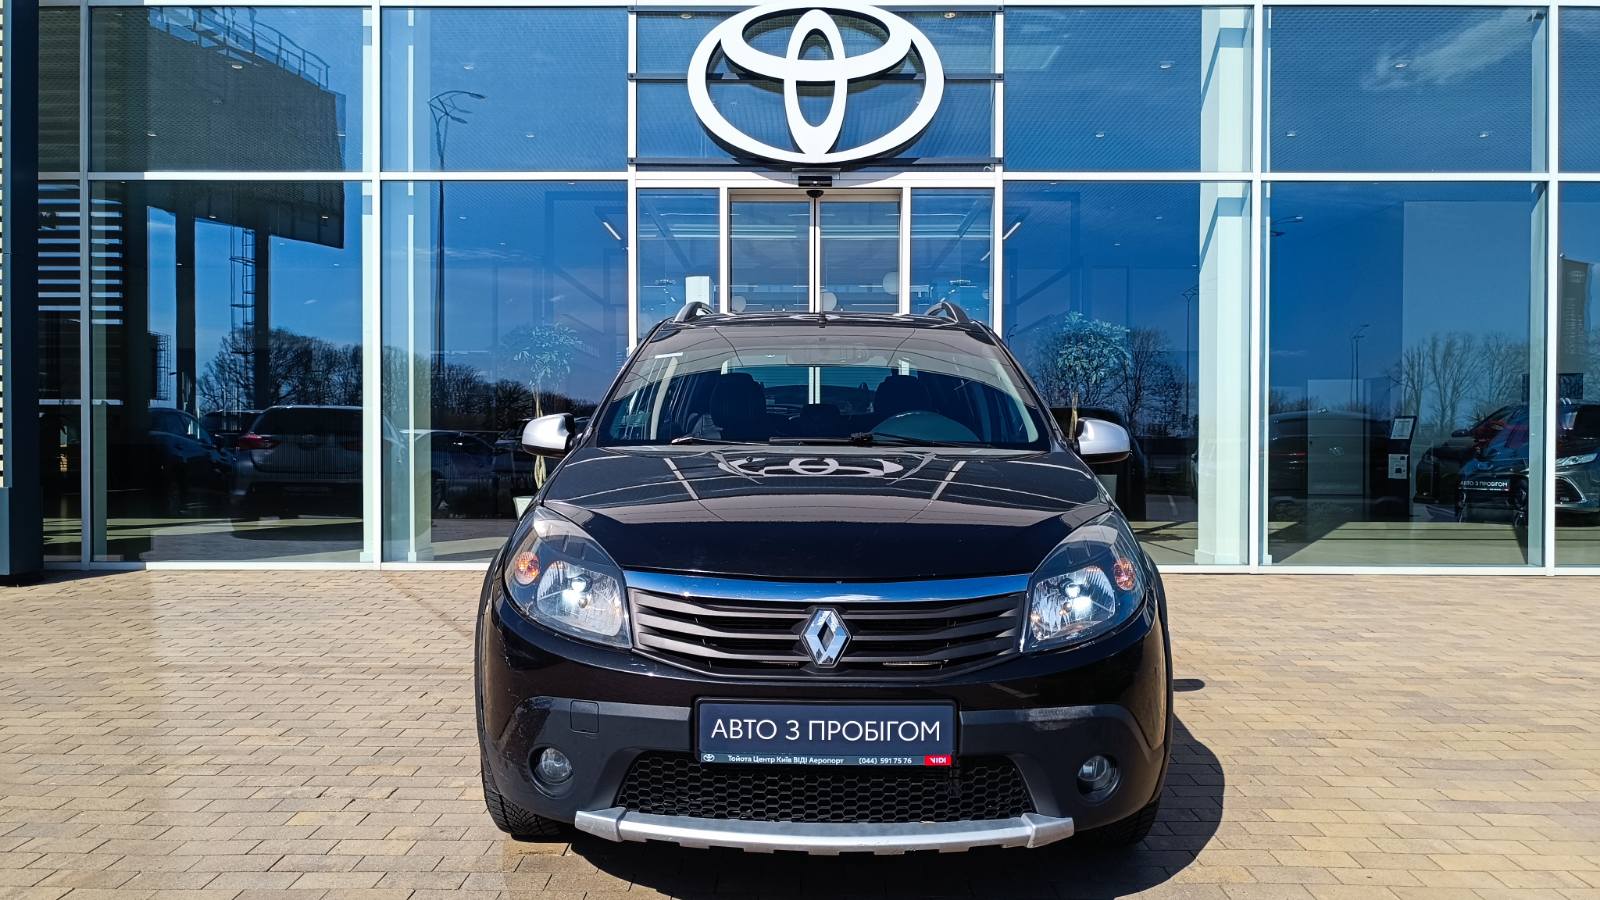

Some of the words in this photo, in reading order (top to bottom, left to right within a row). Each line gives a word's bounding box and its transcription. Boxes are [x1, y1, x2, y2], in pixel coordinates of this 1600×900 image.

[711, 718, 778, 740] АВТО
[785, 719, 800, 741] З
[808, 720, 940, 742] ПРОБІГОМ
[753, 756, 776, 764] Центр
[793, 756, 808, 764] ВІДІ
[808, 757, 844, 765] Аеропорт
[858, 757, 877, 765] (044)
